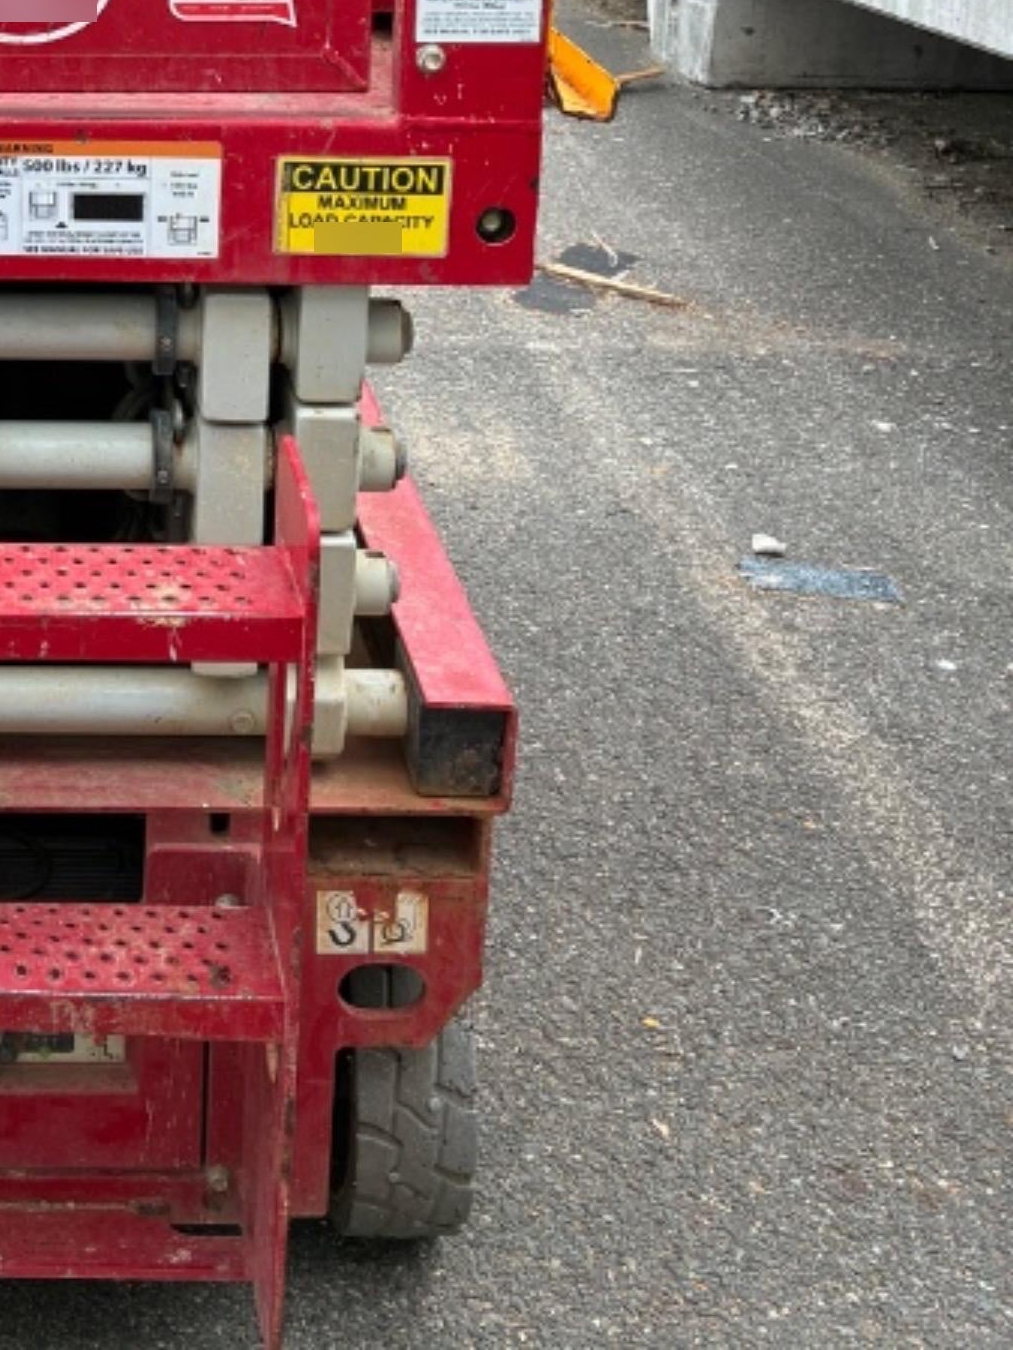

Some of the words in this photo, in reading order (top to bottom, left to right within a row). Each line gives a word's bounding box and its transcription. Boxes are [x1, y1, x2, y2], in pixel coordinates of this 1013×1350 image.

[22, 159, 54, 173] 500
[56, 159, 81, 173] lbs
[94, 160, 124, 175] 227
[127, 160, 148, 178] kg
[292, 165, 438, 192] CAUTION
[319, 195, 407, 210] MAXIMUM
[289, 213, 339, 229] LOAD
